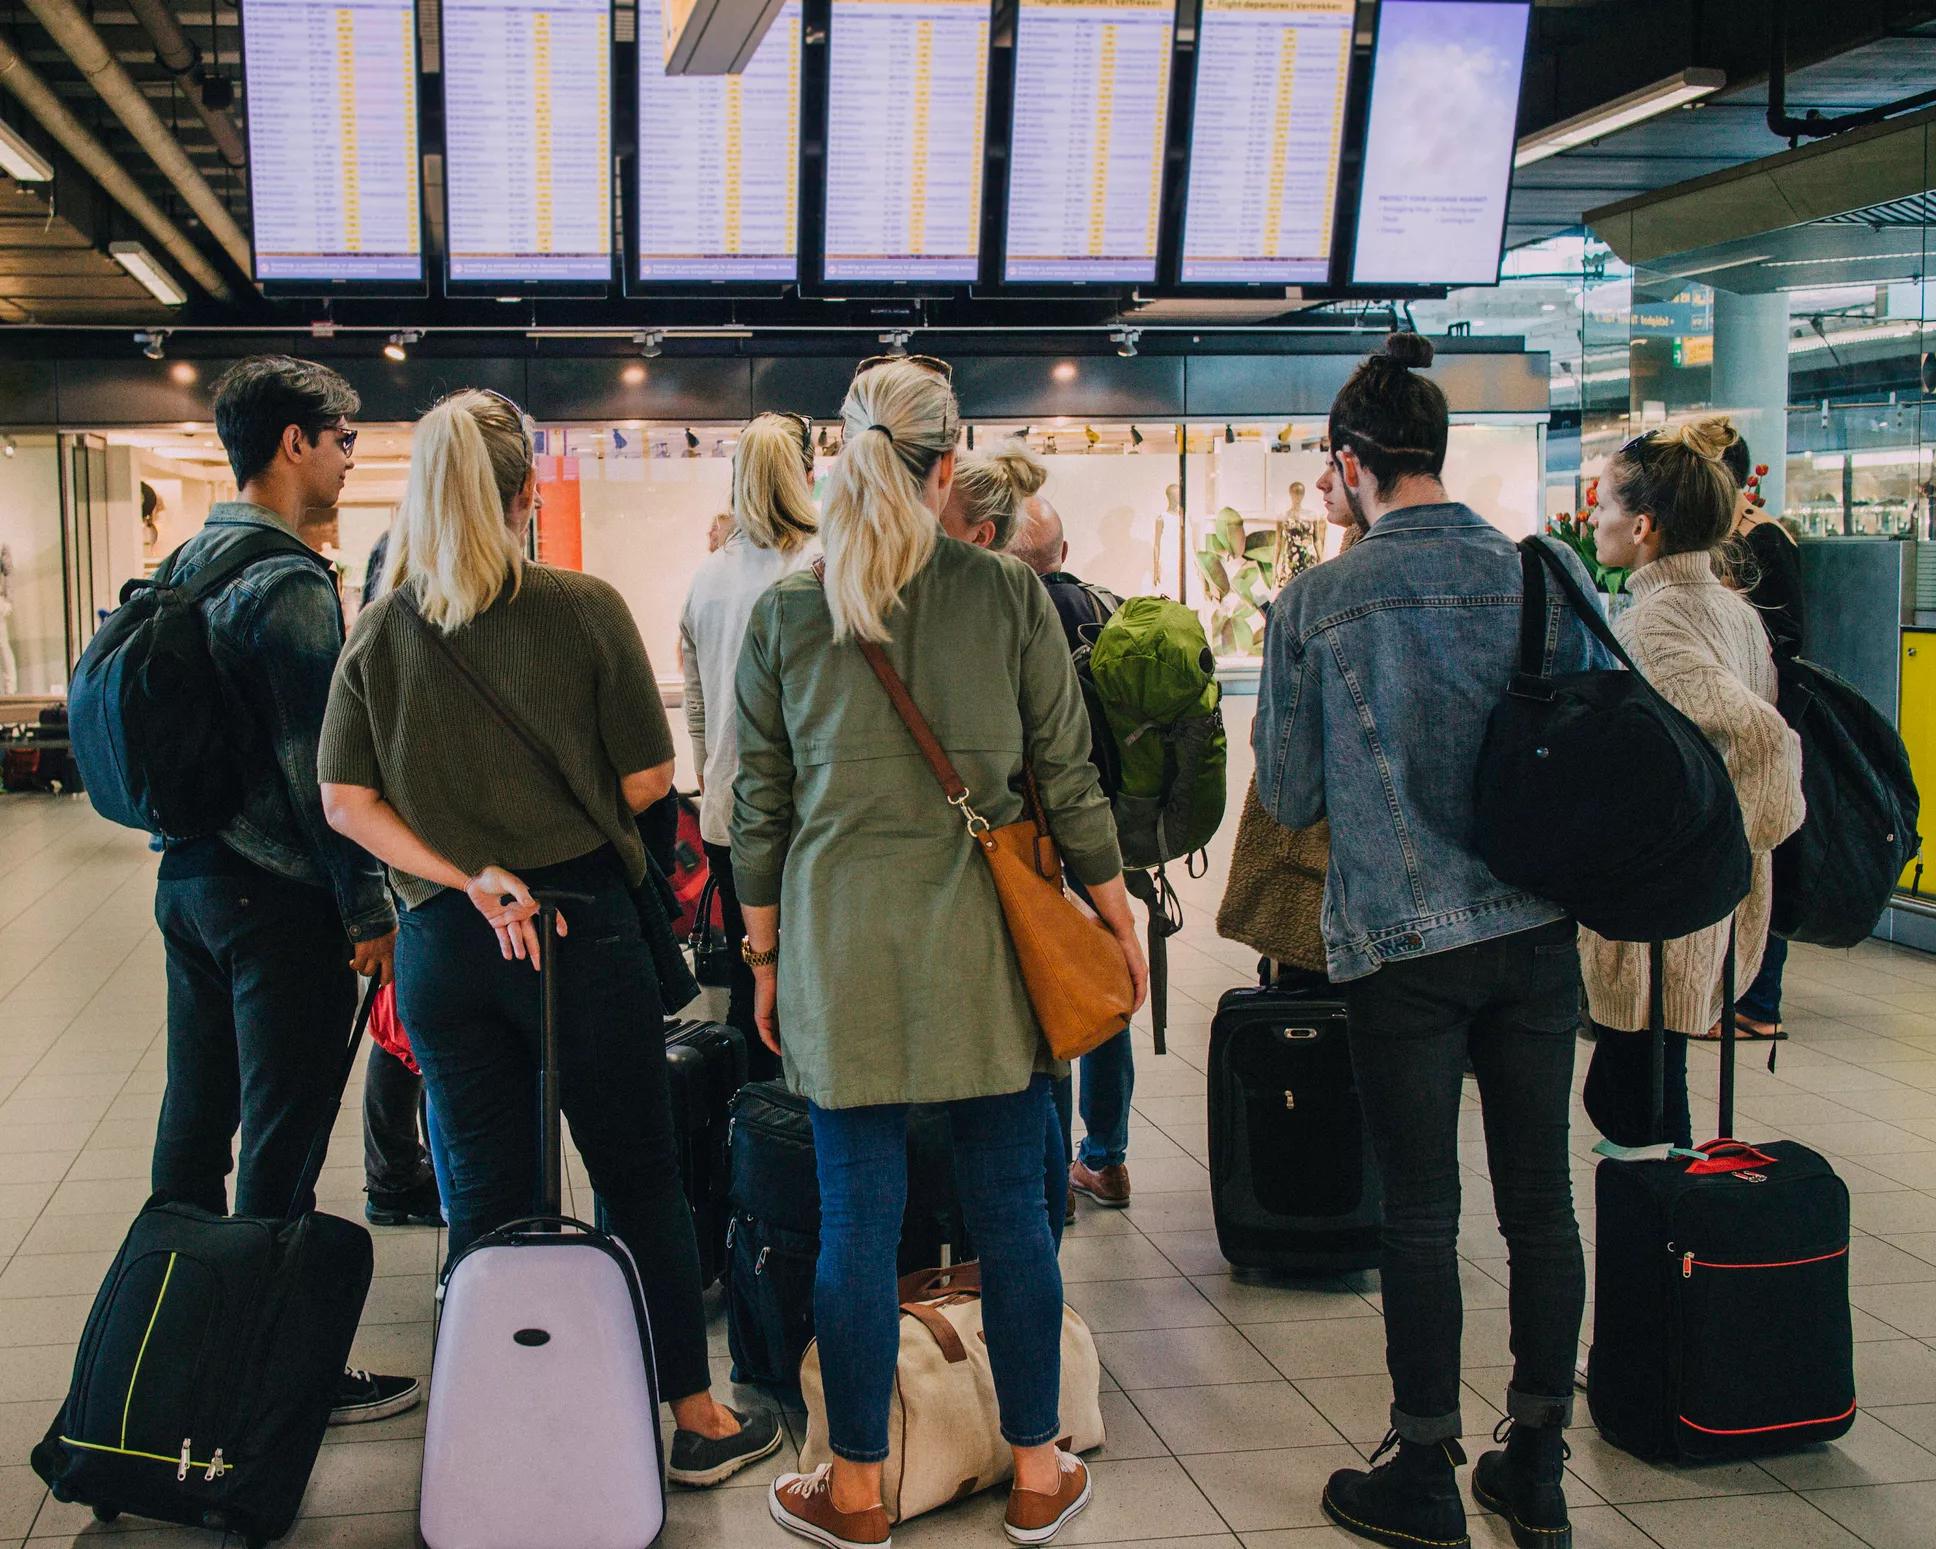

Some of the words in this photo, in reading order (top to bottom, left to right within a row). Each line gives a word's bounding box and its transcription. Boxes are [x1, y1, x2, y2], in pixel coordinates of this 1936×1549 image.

[1217, 0, 1241, 10] Flight
[1244, 1, 1289, 11] departures
[1296, 2, 1342, 10] Vertrekken
